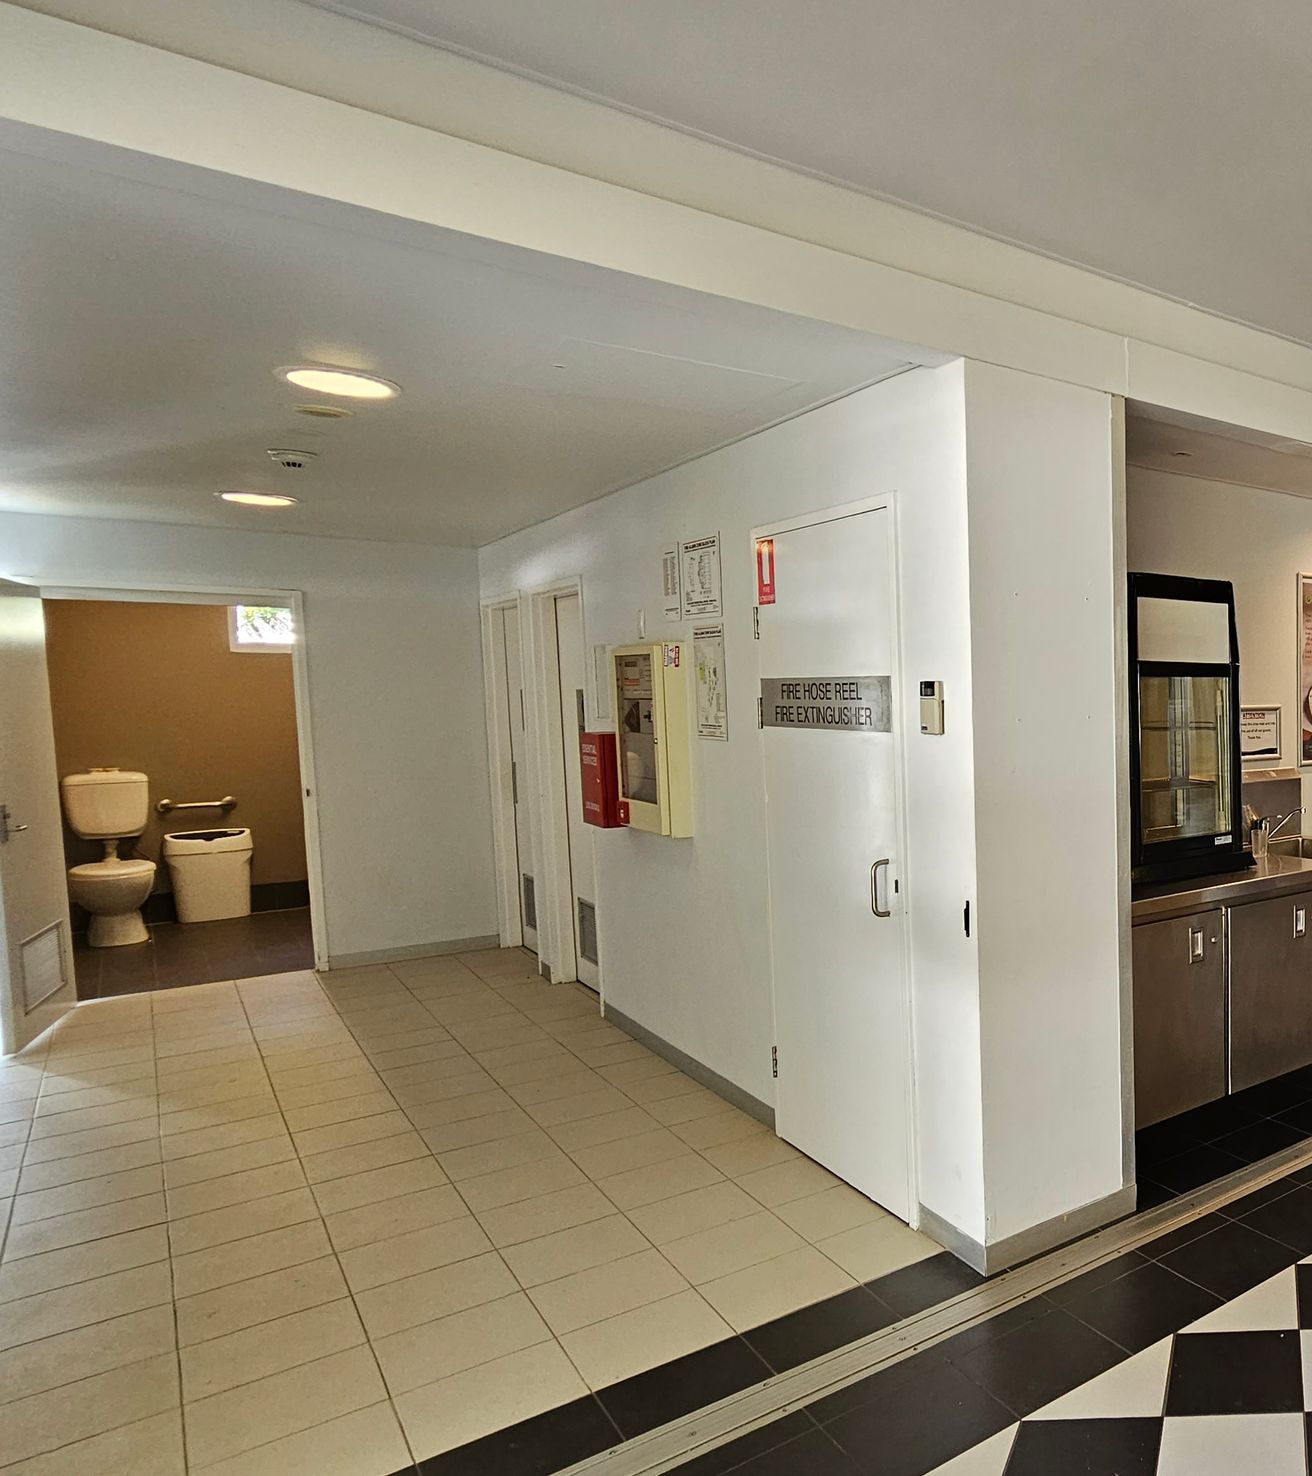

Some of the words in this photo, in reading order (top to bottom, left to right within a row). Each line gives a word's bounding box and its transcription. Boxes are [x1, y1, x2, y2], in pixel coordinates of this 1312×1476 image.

[781, 683, 801, 700] FIRE
[803, 682, 832, 700] HOSE
[834, 682, 862, 700] REEL
[775, 705, 795, 722] FIRE
[796, 705, 872, 726] EXTINGUISHER
